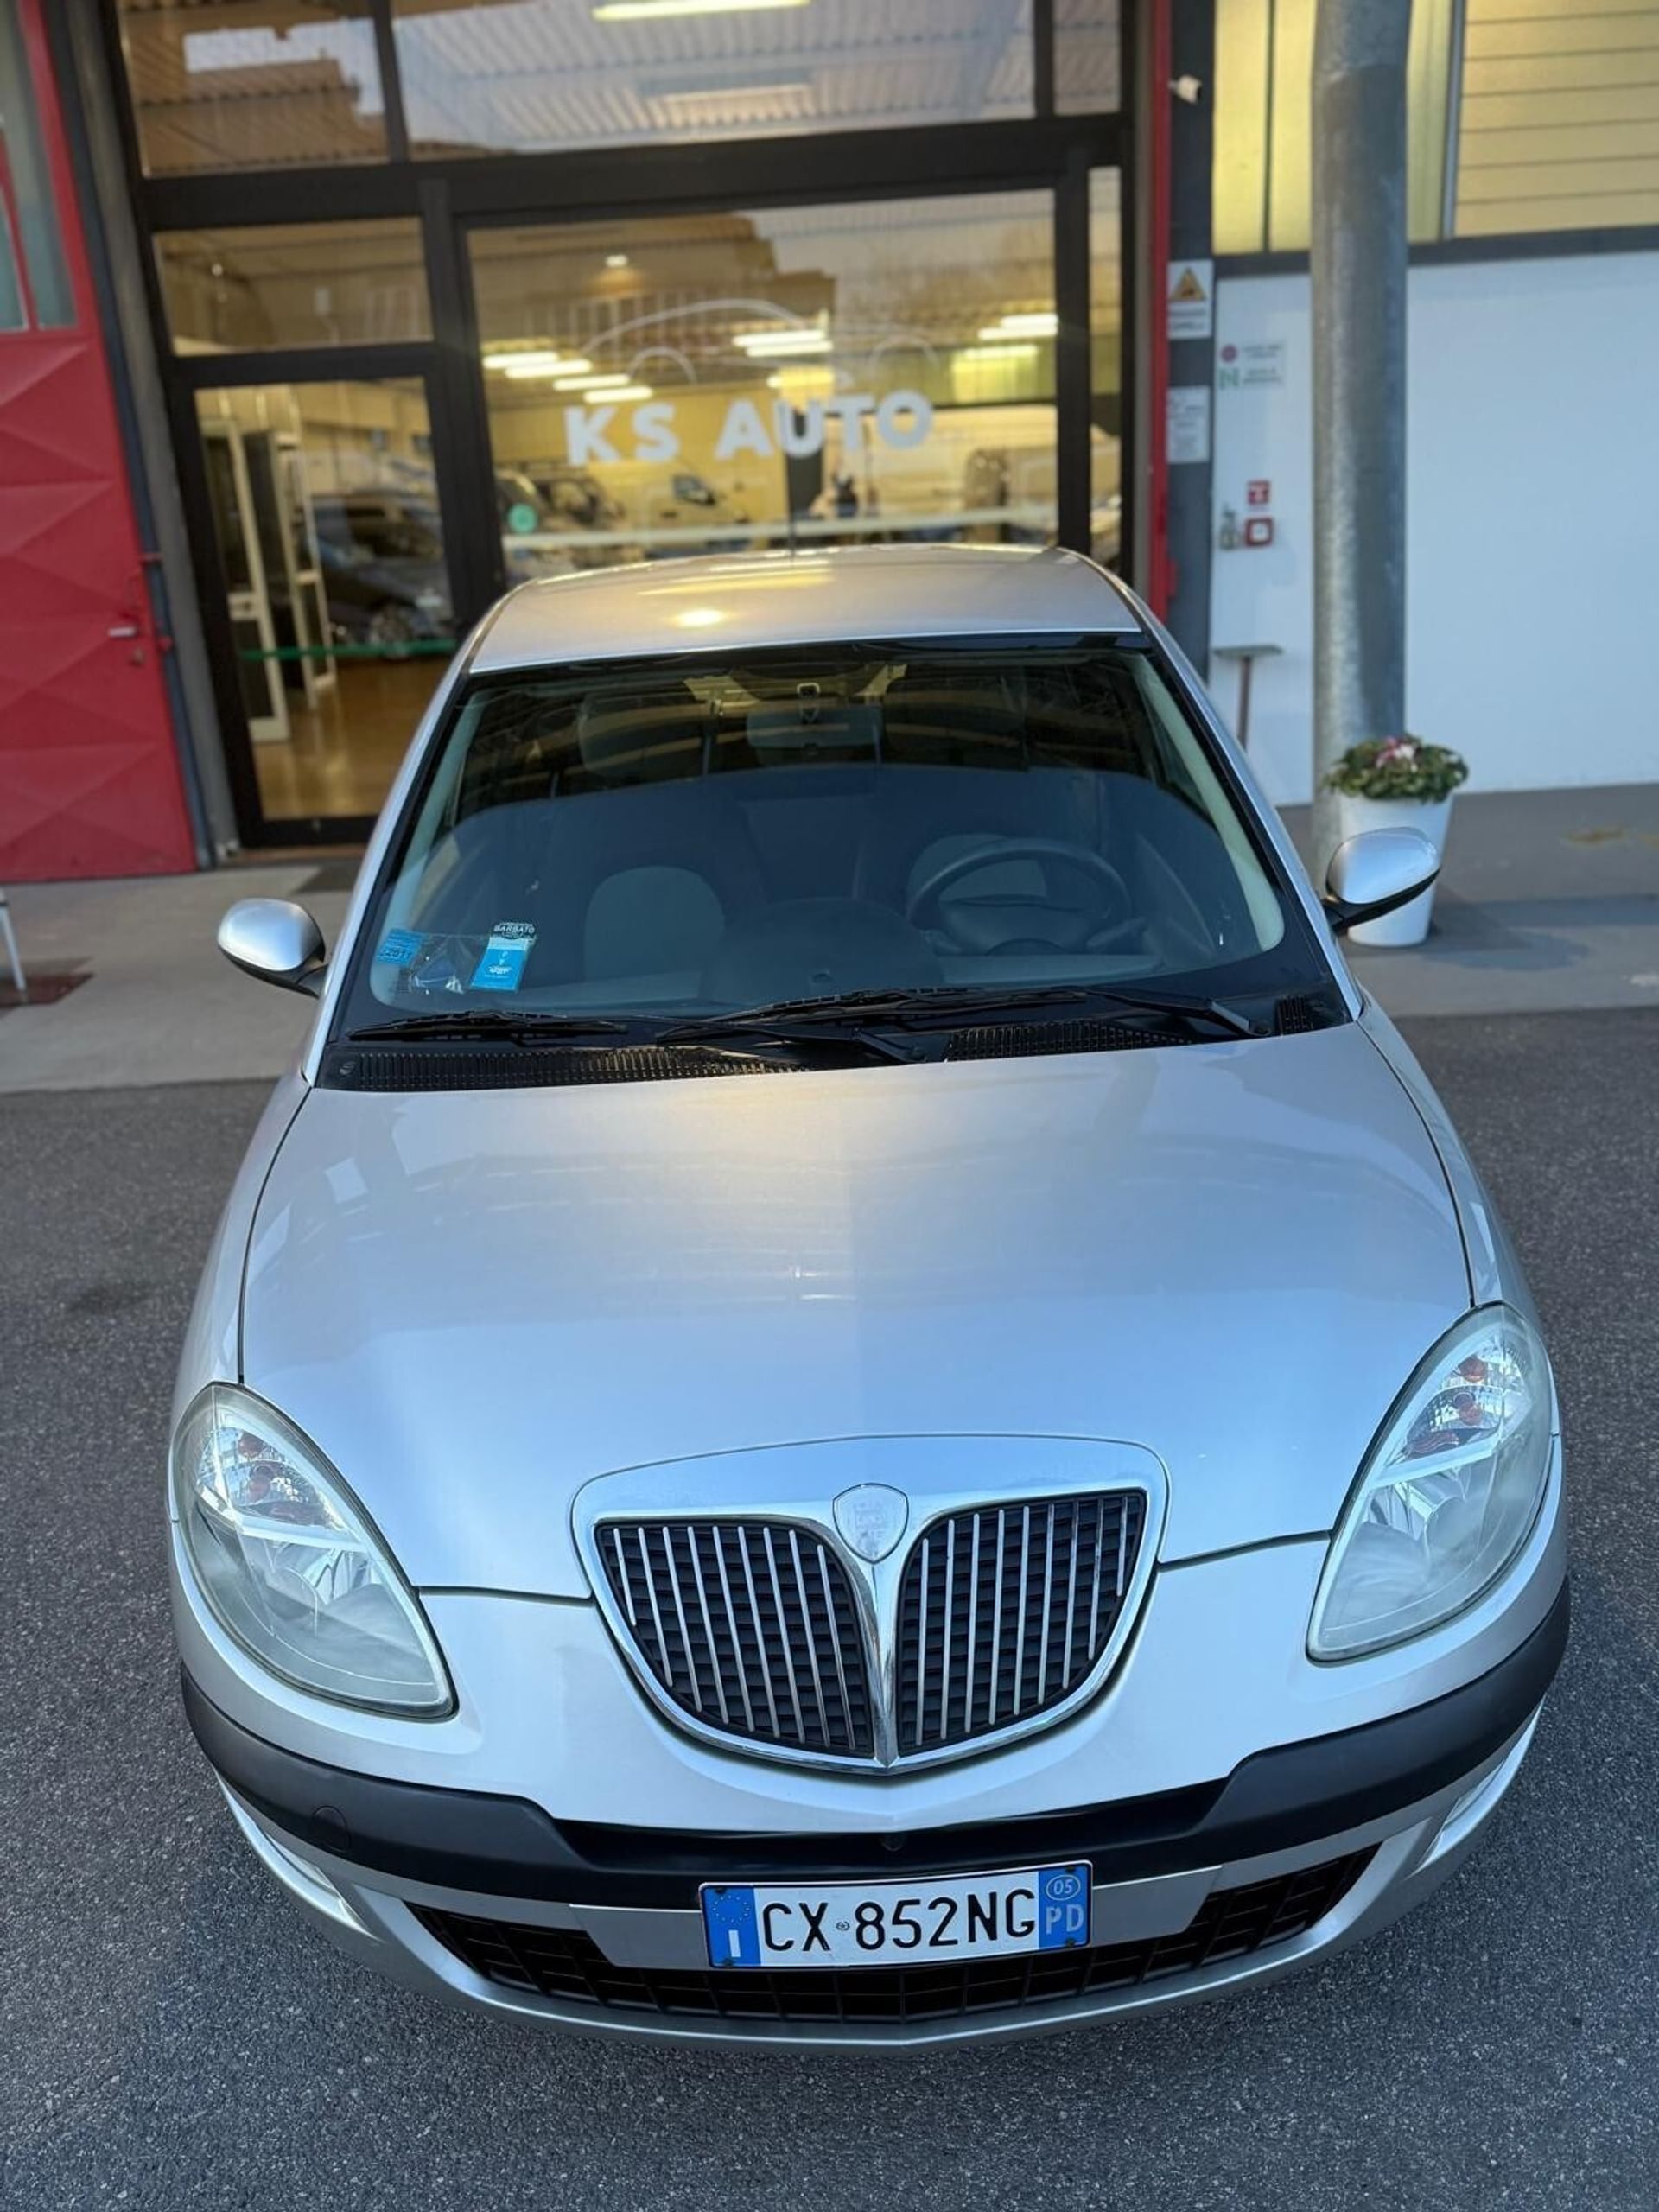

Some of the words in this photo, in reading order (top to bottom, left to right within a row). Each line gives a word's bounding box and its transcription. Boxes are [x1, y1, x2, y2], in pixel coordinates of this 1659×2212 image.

[563, 404, 680, 467] KS
[716, 391, 933, 461] AUTO
[1053, 1878, 1073, 1895] 05
[1045, 1904, 1084, 1935] PD
